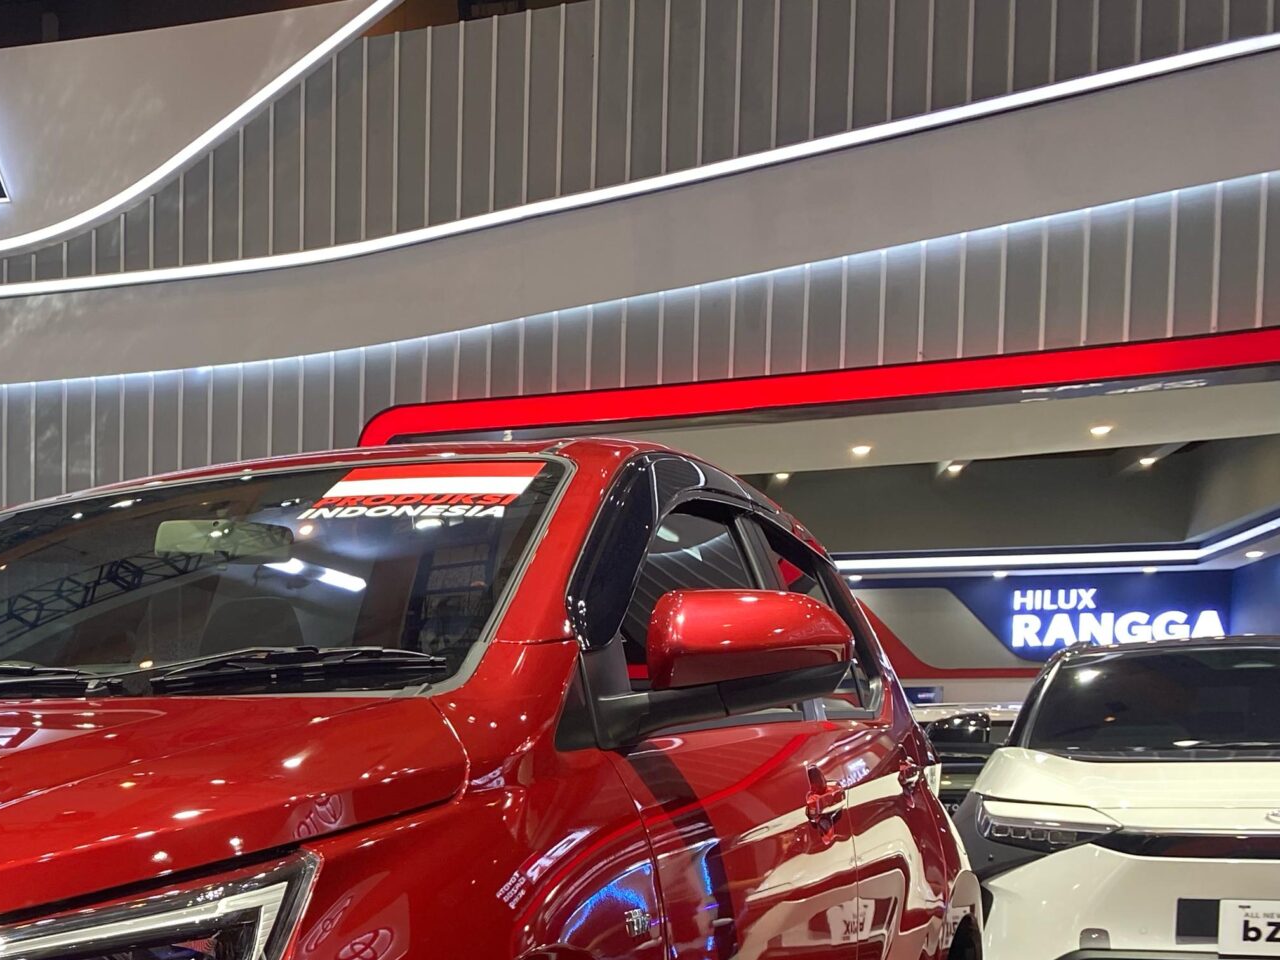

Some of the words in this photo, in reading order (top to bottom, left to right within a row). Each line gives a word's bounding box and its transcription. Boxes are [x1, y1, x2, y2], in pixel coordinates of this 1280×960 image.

[312, 493, 521, 509] PRODUKSI
[296, 504, 506, 520] INDONESIA
[1012, 588, 1097, 611] HILUX
[1011, 610, 1226, 648] RANGGA
